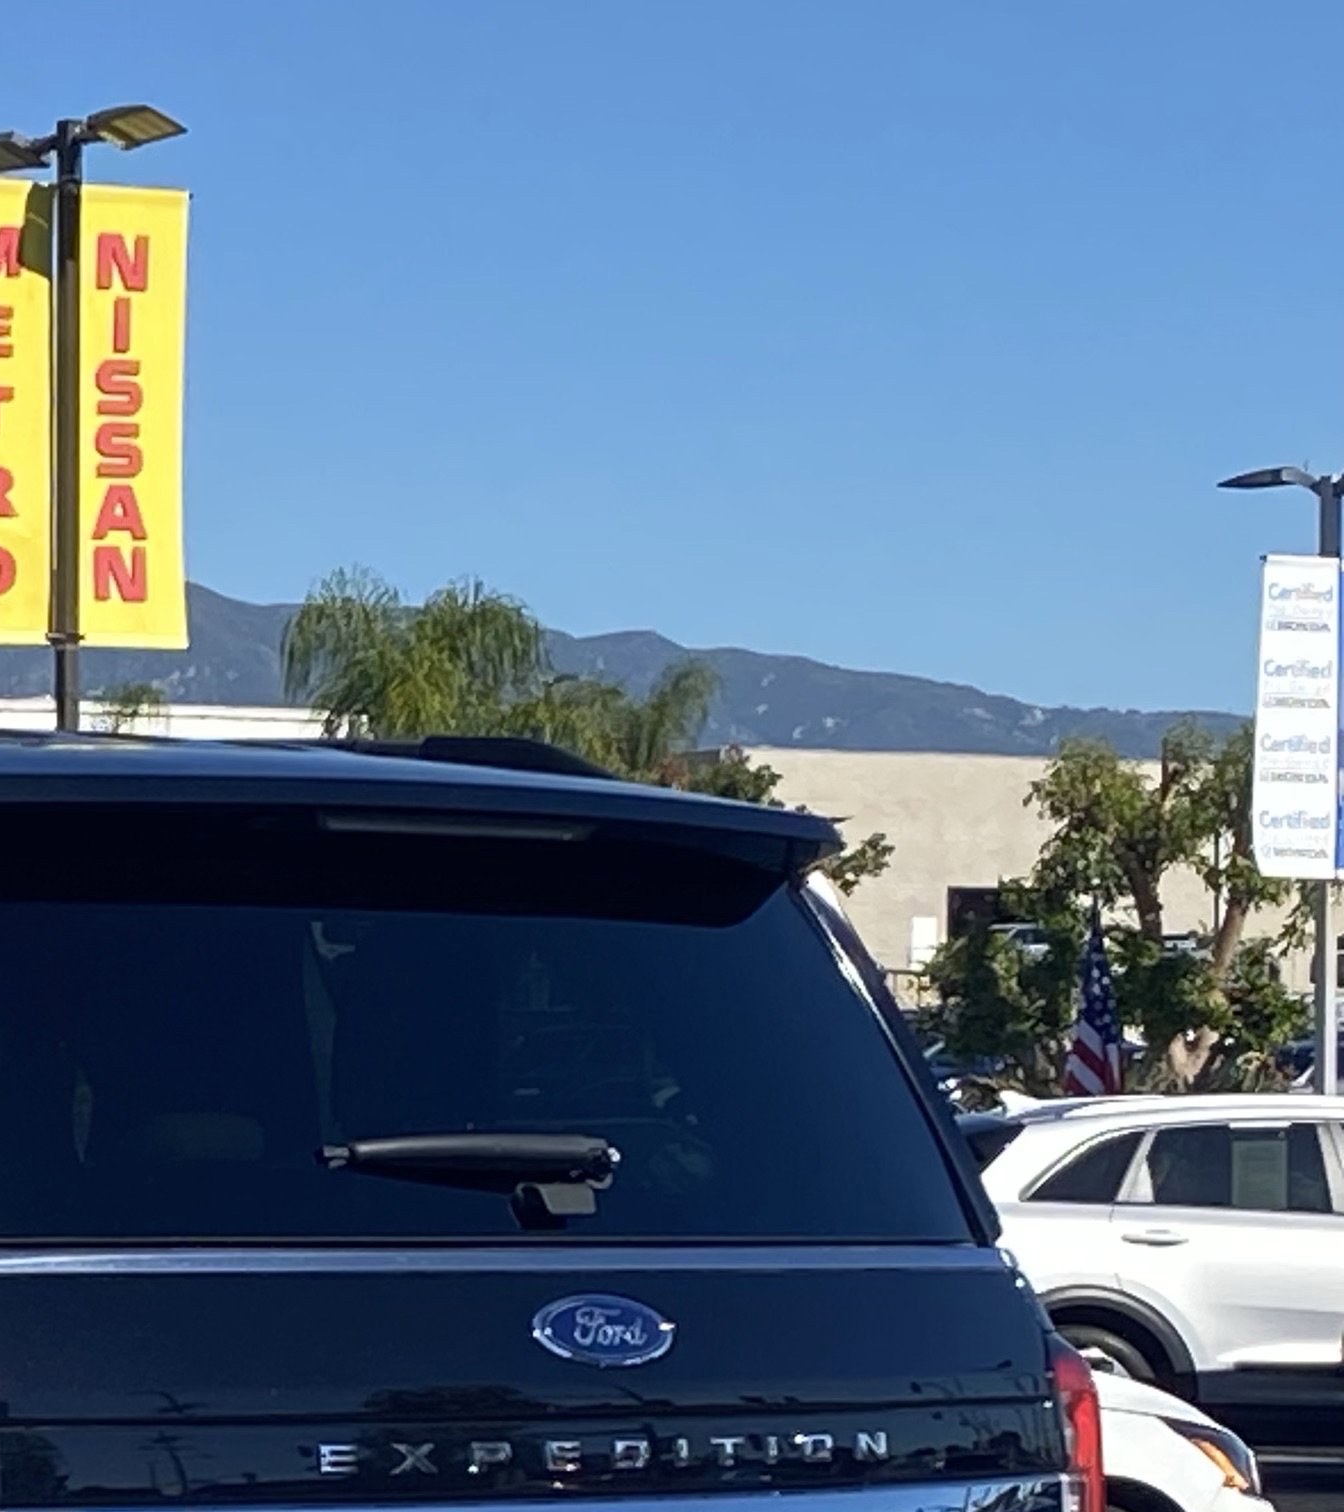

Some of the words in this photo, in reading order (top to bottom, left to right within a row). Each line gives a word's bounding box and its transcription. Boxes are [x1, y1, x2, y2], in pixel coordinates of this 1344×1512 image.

[92, 233, 150, 602] NISSAN
[1264, 659, 1332, 678] Certified
[1260, 733, 1331, 754] Certified
[1259, 810, 1331, 829] Certified
[573, 1307, 647, 1346] Ford
[319, 1431, 888, 1475] EXPEDITION
